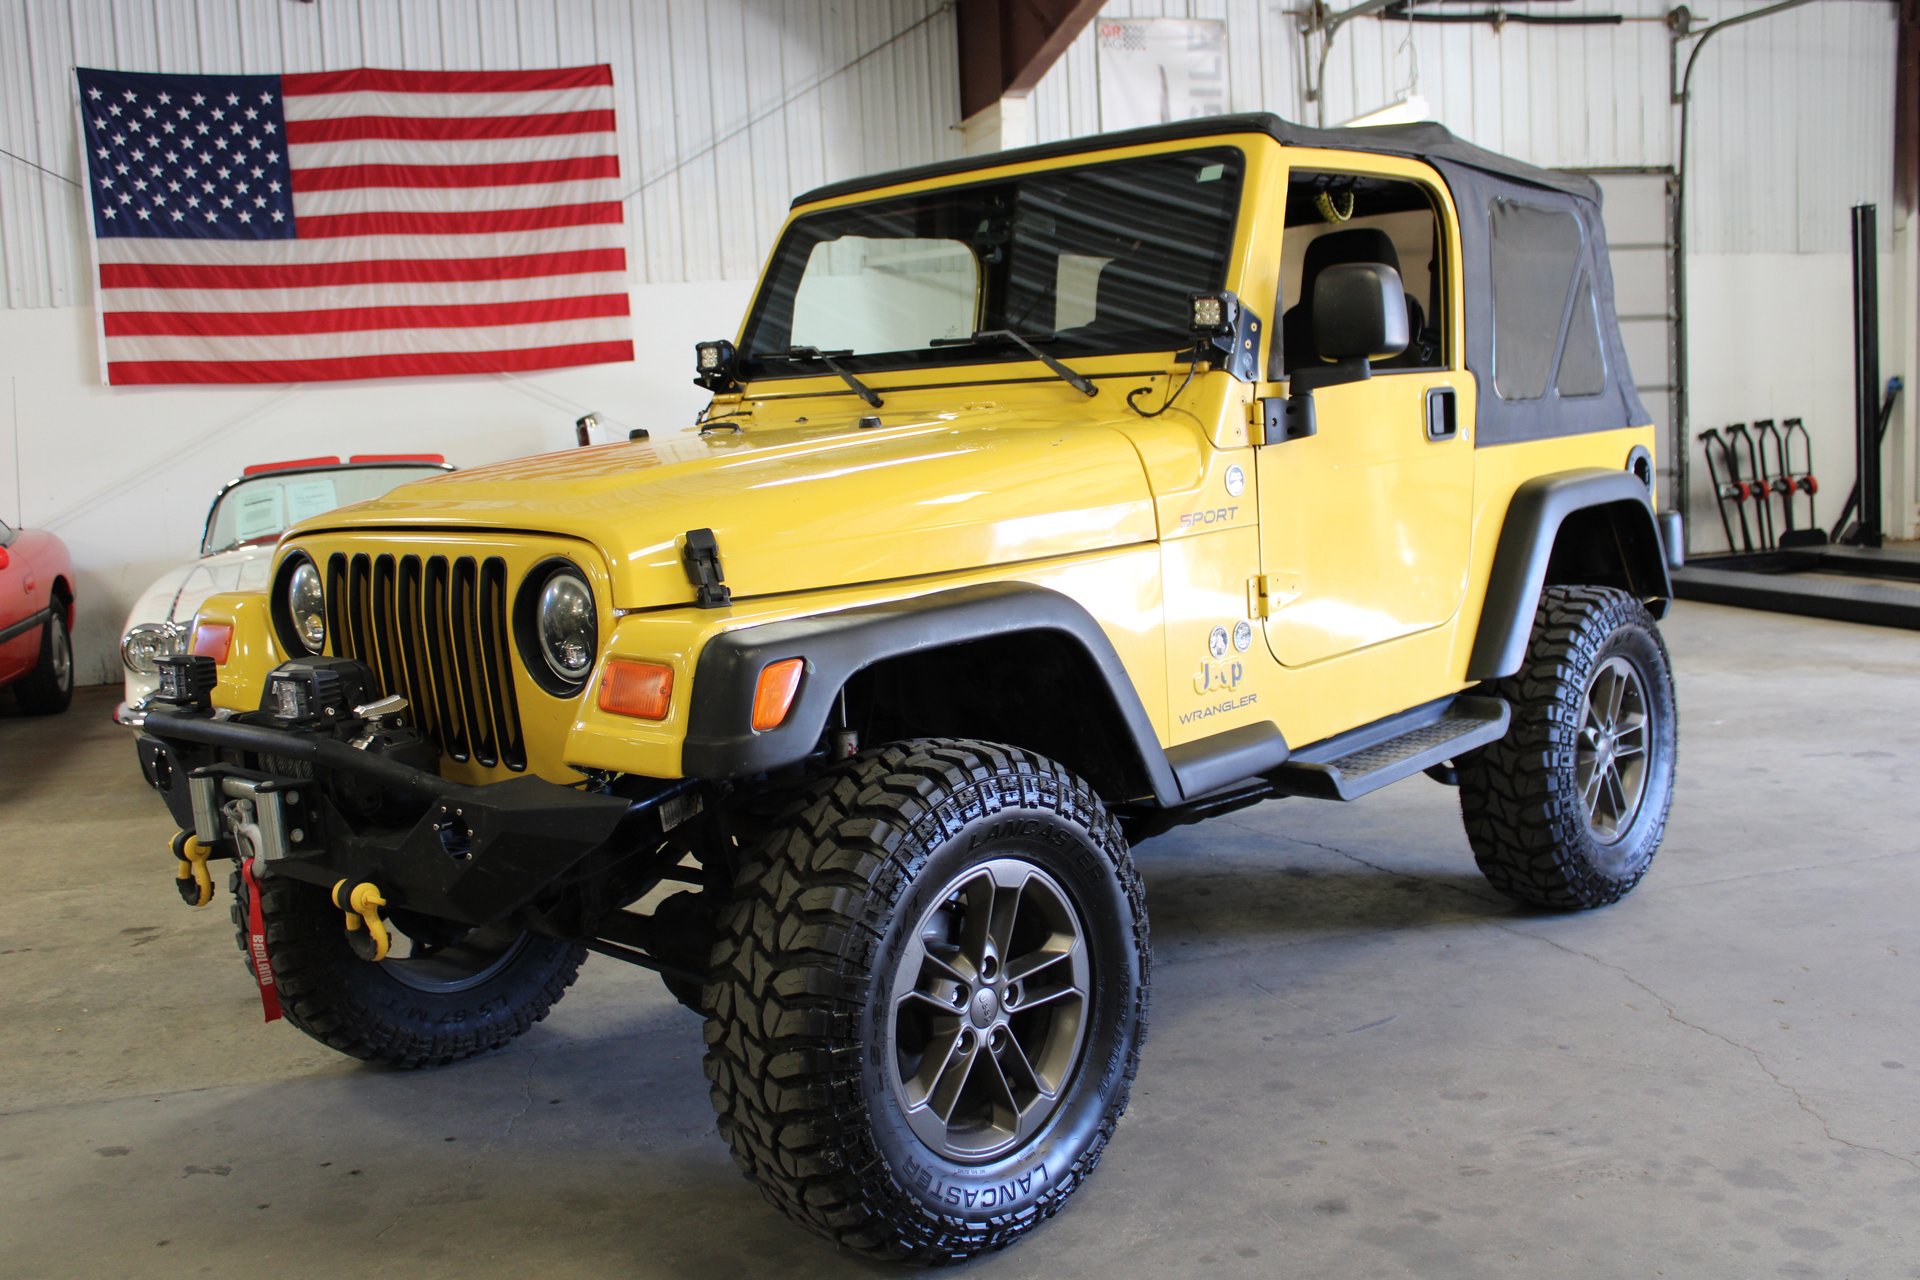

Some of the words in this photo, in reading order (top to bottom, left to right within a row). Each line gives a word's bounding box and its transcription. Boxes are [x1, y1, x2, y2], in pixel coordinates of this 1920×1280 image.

[1101, 24, 1121, 37] GR
[1180, 506, 1239, 528] SPORT
[1178, 693, 1258, 725] WRANGLER
[967, 818, 1106, 883] LANCASTER
[252, 934, 274, 986] BADLAND
[979, 993, 992, 1023] Jeep
[902, 1155, 1049, 1209] LANCASTER
